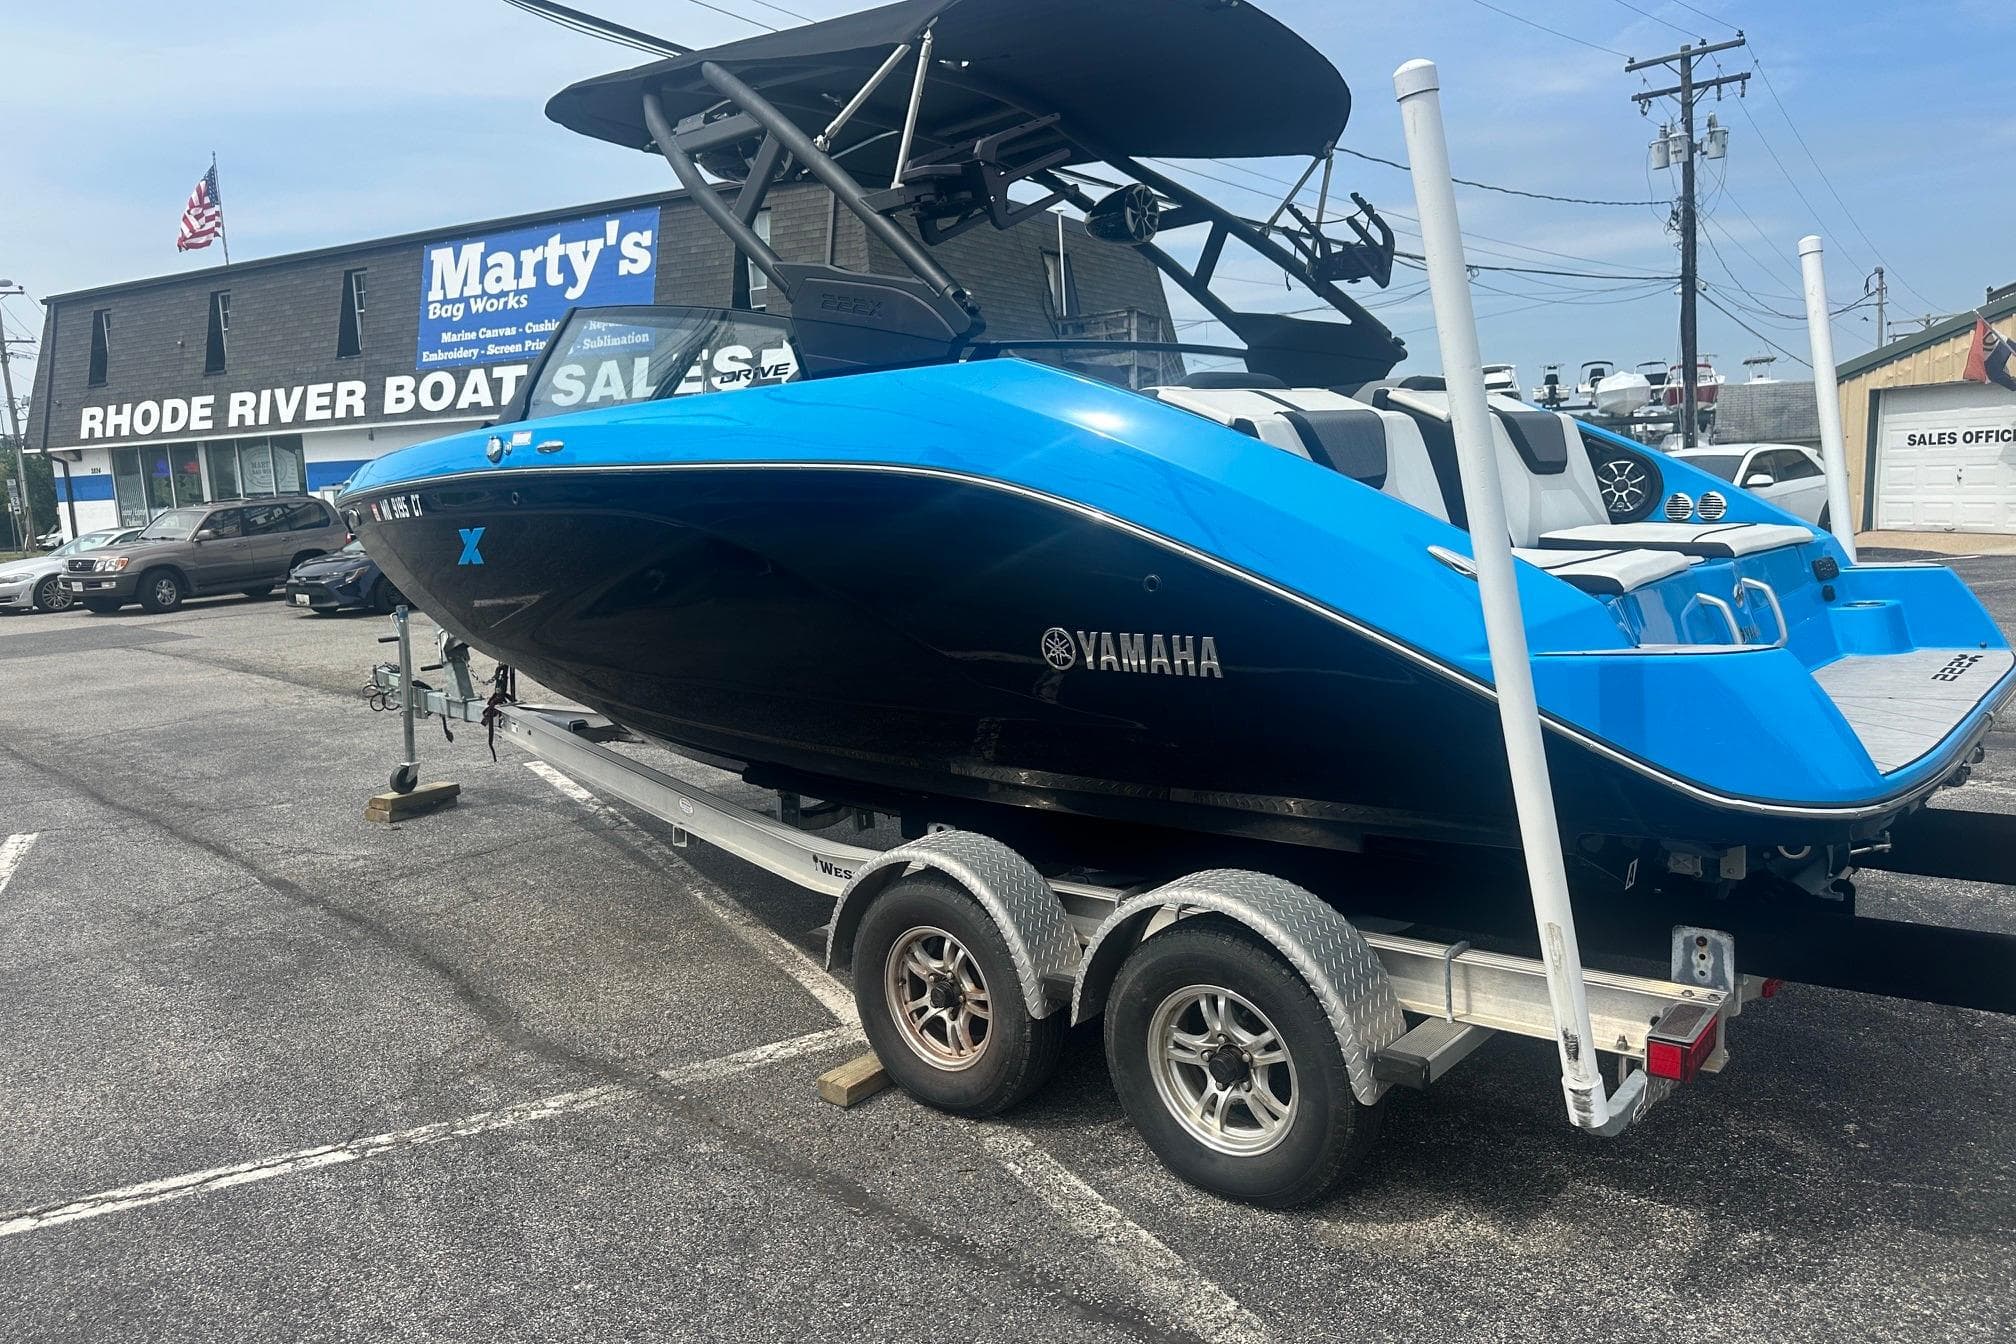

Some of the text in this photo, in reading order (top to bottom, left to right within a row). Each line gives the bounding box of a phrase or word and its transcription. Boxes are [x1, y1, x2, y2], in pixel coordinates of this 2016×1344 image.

[428, 219, 653, 301] Marty's
[427, 291, 529, 322] Bag Works
[422, 347, 479, 363] Embroidery
[486, 342, 525, 356] Screen
[583, 331, 650, 350] Sublimation
[441, 330, 477, 344] Marine
[478, 326, 517, 339] Canvas
[79, 394, 215, 440] RHODE
[227, 379, 368, 428] RIVER
[383, 364, 529, 416] BOAT
[1907, 431, 1958, 447] SALES
[457, 527, 486, 565] X
[1076, 630, 1224, 679] YAMAHA
[819, 860, 855, 880] WES
